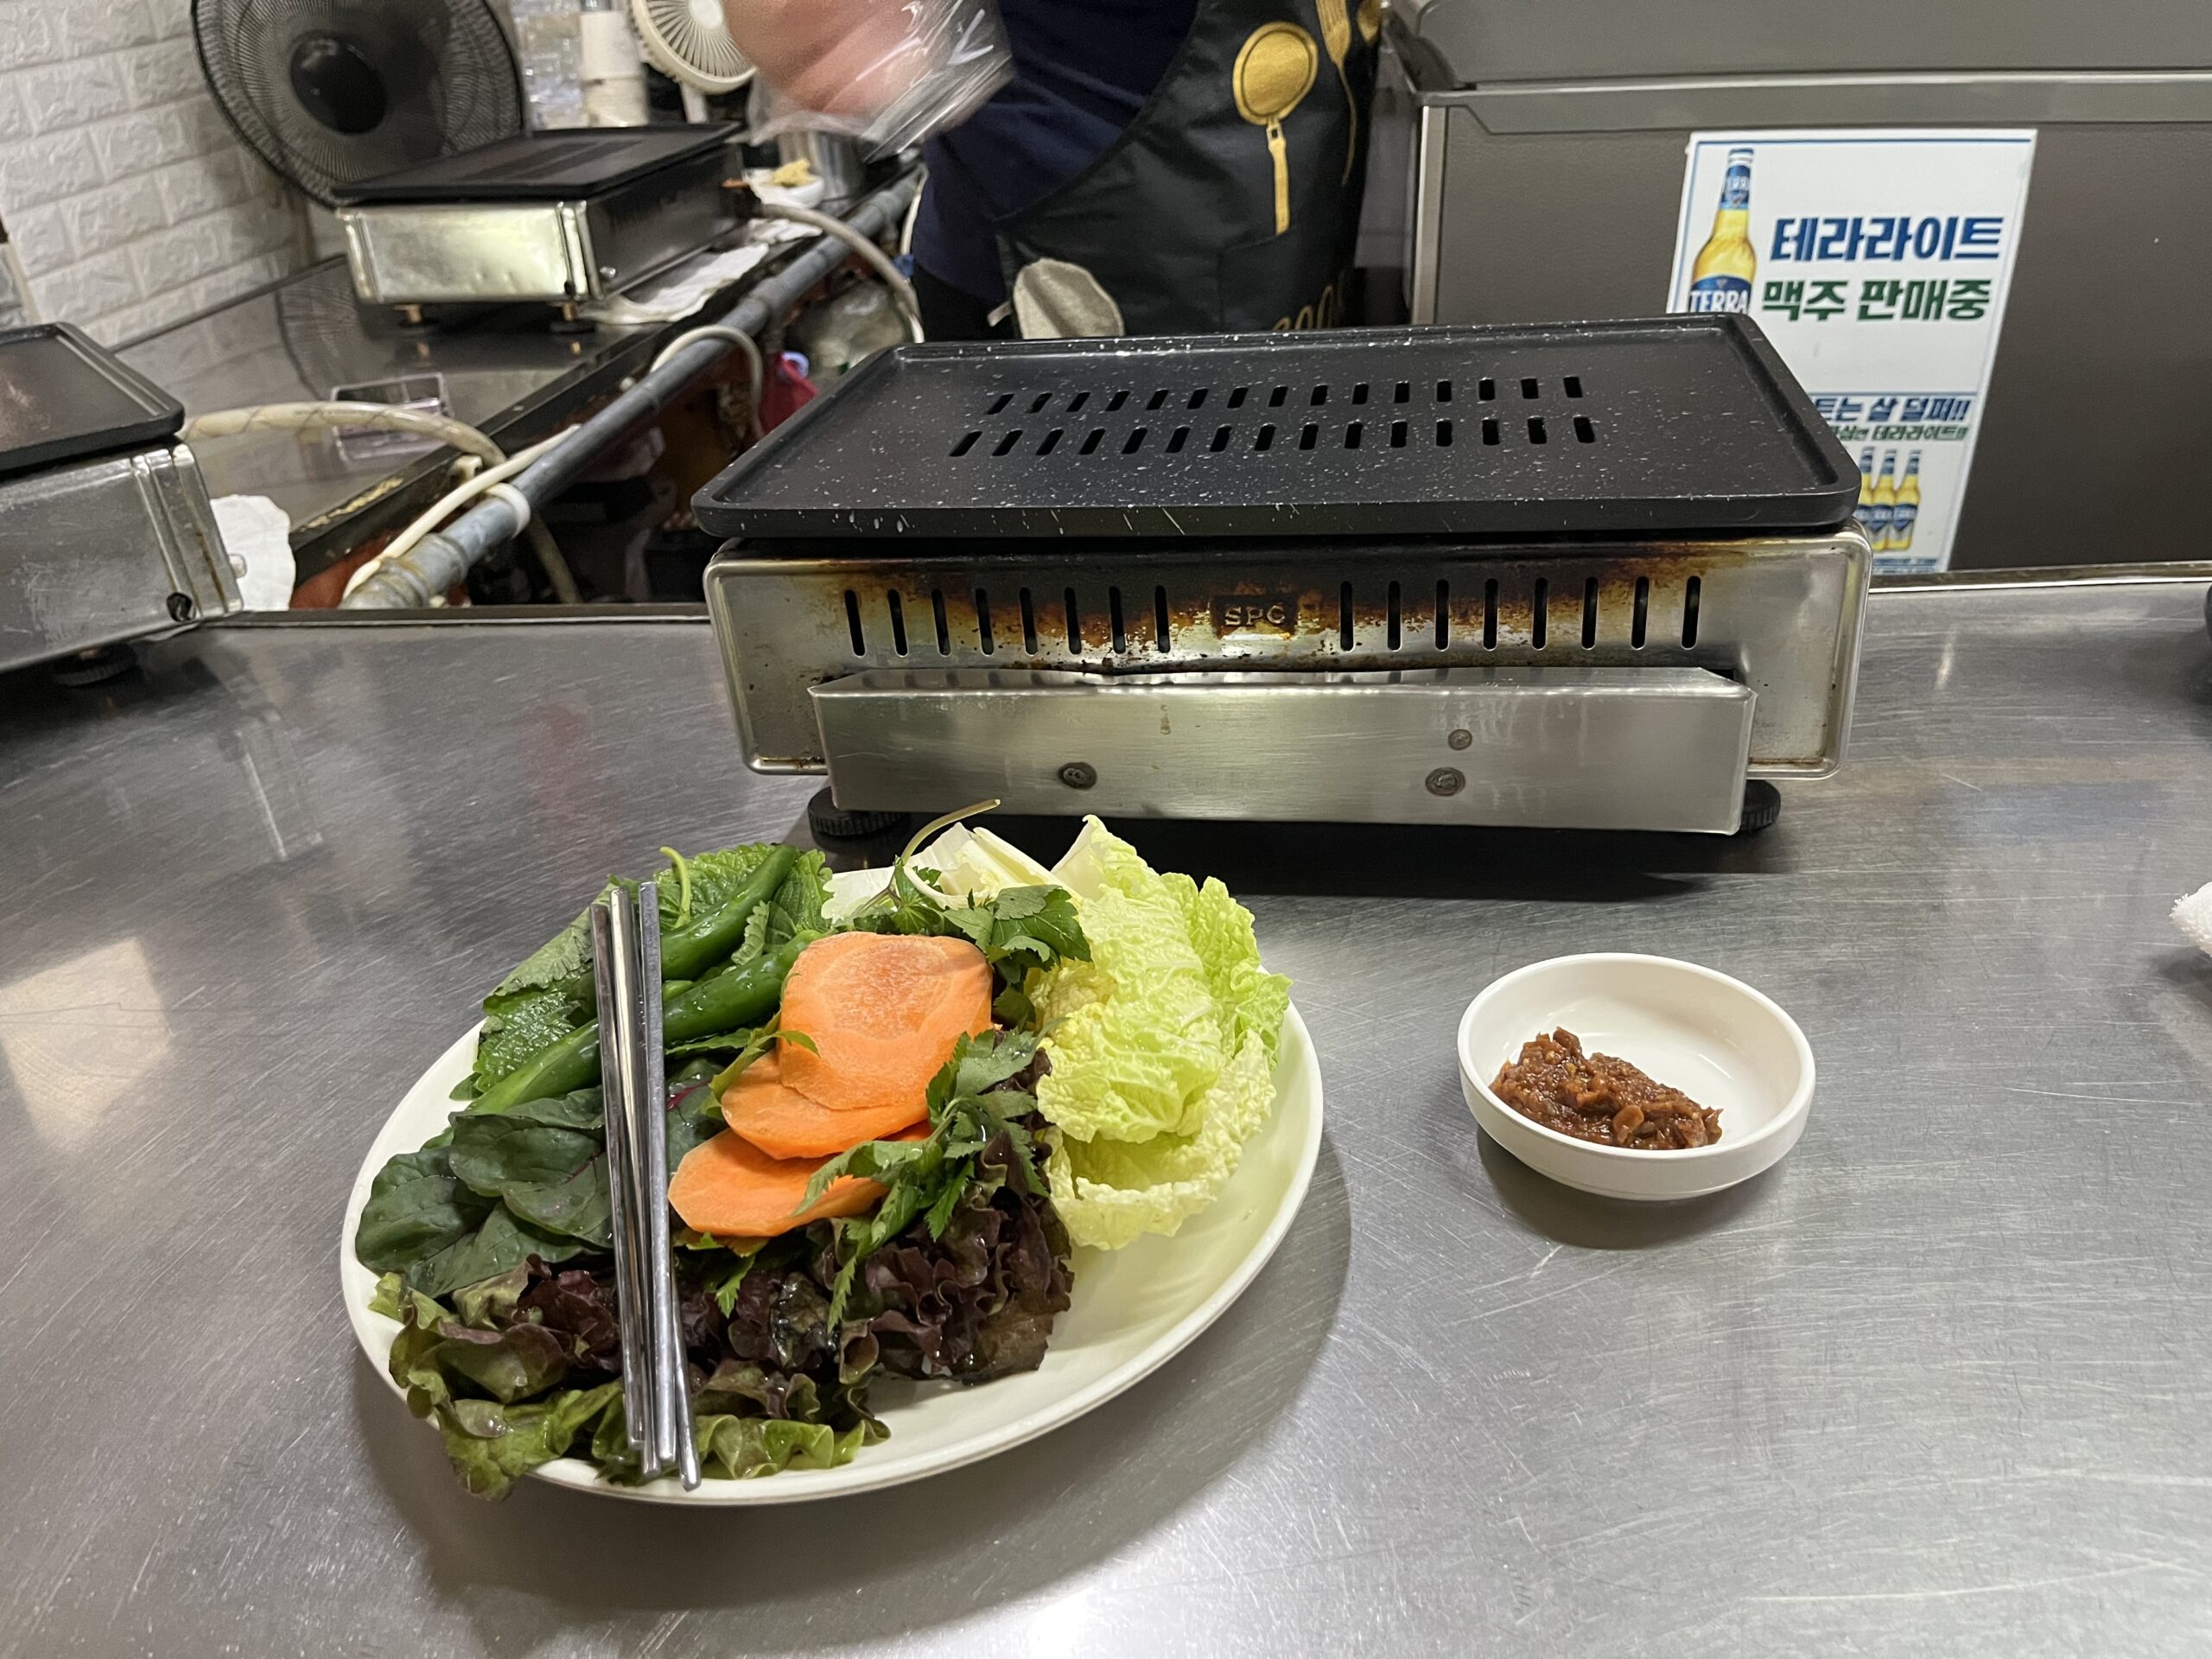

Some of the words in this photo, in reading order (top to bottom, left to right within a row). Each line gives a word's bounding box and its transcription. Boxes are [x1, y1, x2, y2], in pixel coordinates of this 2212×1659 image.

[1770, 217, 2004, 261] 테라라이트
[1690, 289, 1749, 314] TERRA
[1763, 279, 1848, 321] 맥주
[1856, 279, 1992, 321] 판매중
[1225, 605, 1286, 626] SPC
